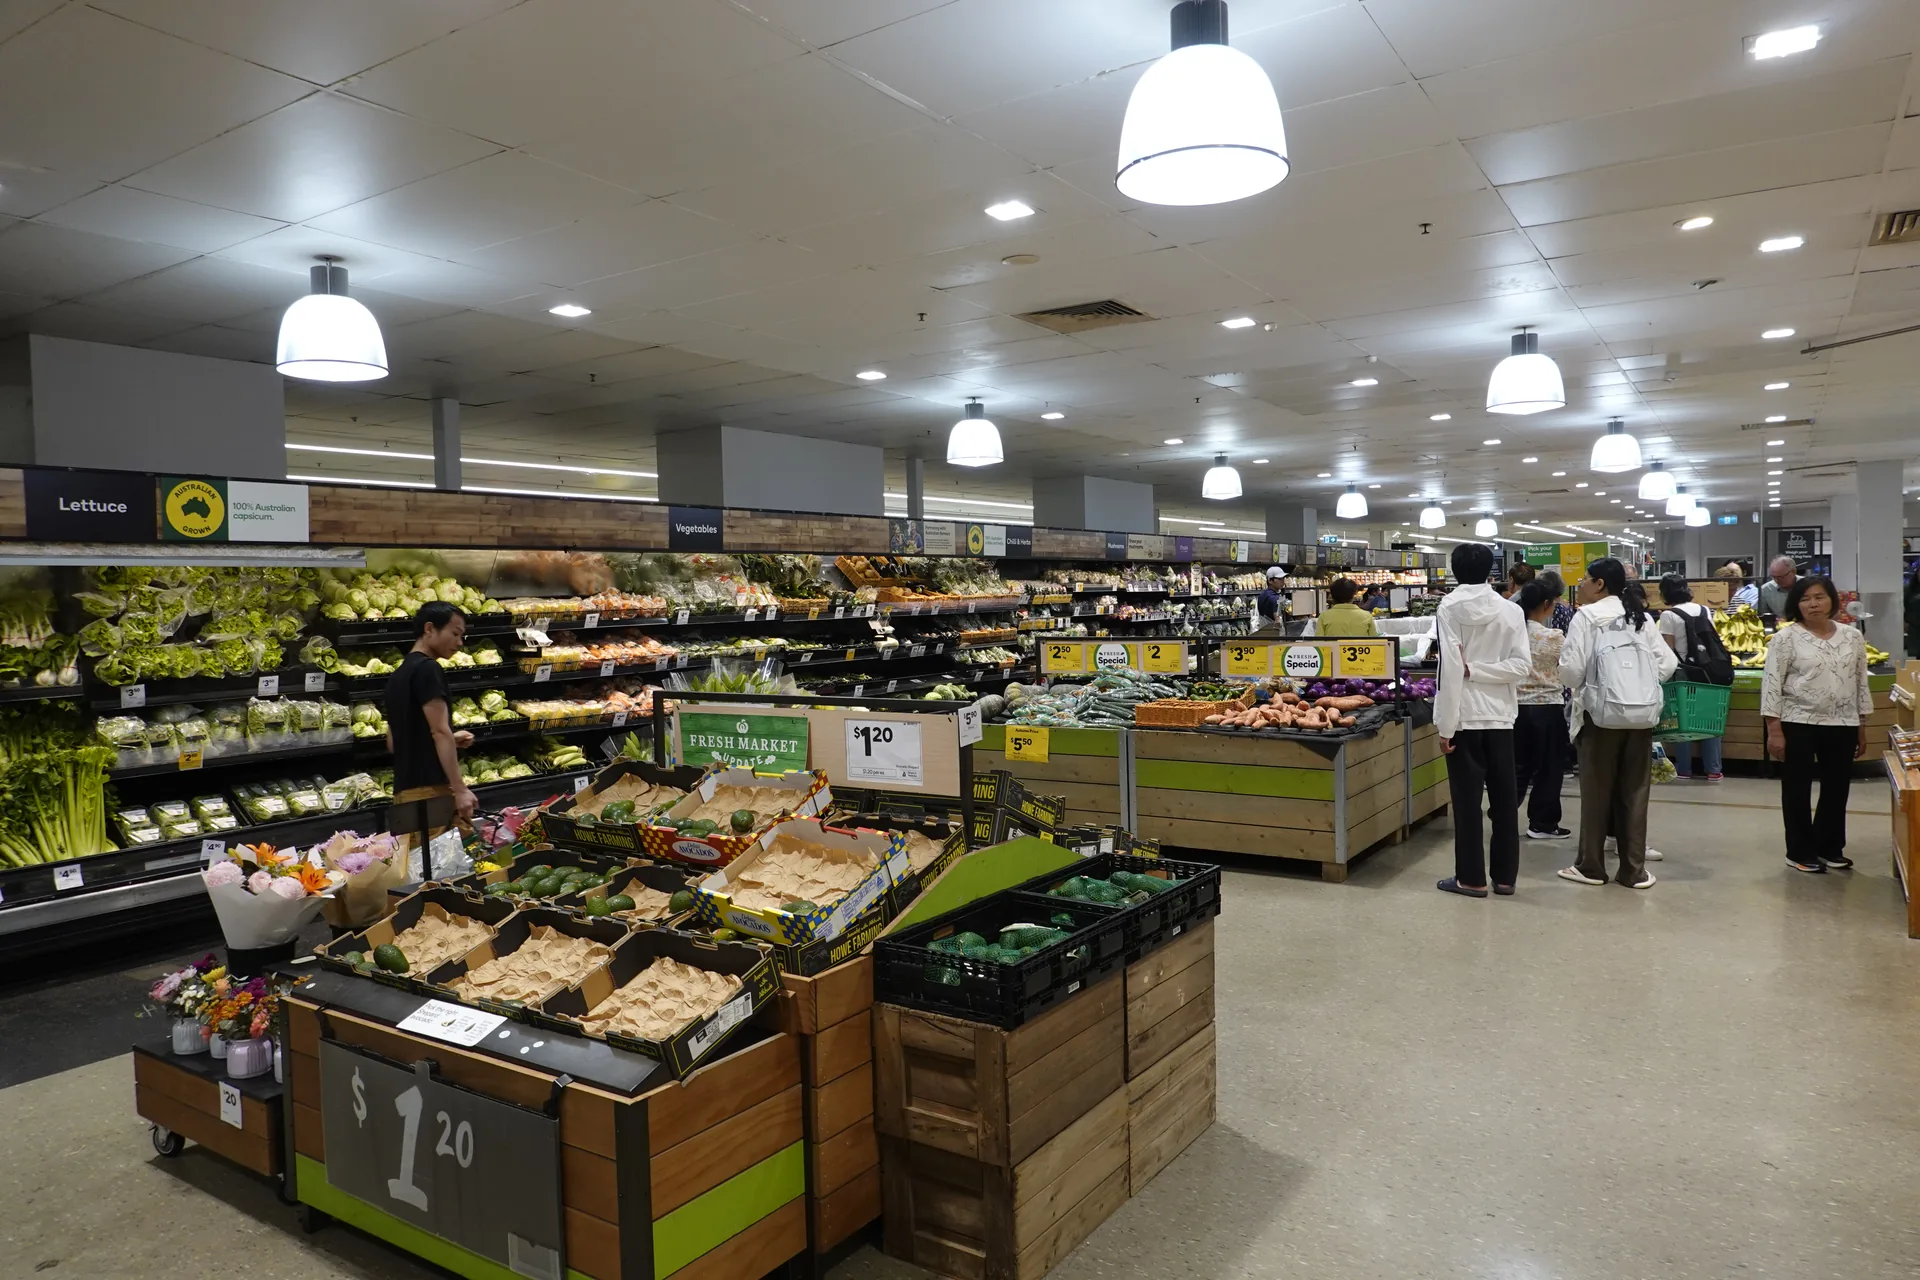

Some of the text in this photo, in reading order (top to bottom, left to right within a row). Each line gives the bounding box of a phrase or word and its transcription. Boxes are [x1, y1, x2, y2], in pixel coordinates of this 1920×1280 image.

[174, 484, 217, 500] AUSTRALIAN
[59, 497, 128, 514] Lettuce
[232, 502, 296, 512] 100% Australian
[232, 512, 275, 521] capsicum.
[182, 525, 211, 535] GROWN
[675, 522, 718, 537] Vegetables
[1098, 656, 1126, 665] Special
[1286, 660, 1319, 670] Special
[690, 734, 798, 753] FRESH MARKET
[723, 753, 763, 767] UPDATE
[574, 828, 597, 844] HOWE
[597, 832, 635, 849] FARMING
[679, 845, 715, 857] AVOCADOS
[732, 915, 771, 933] AVOCADOS
[830, 940, 852, 963] HOWE
[852, 922, 883, 950] FARMING
